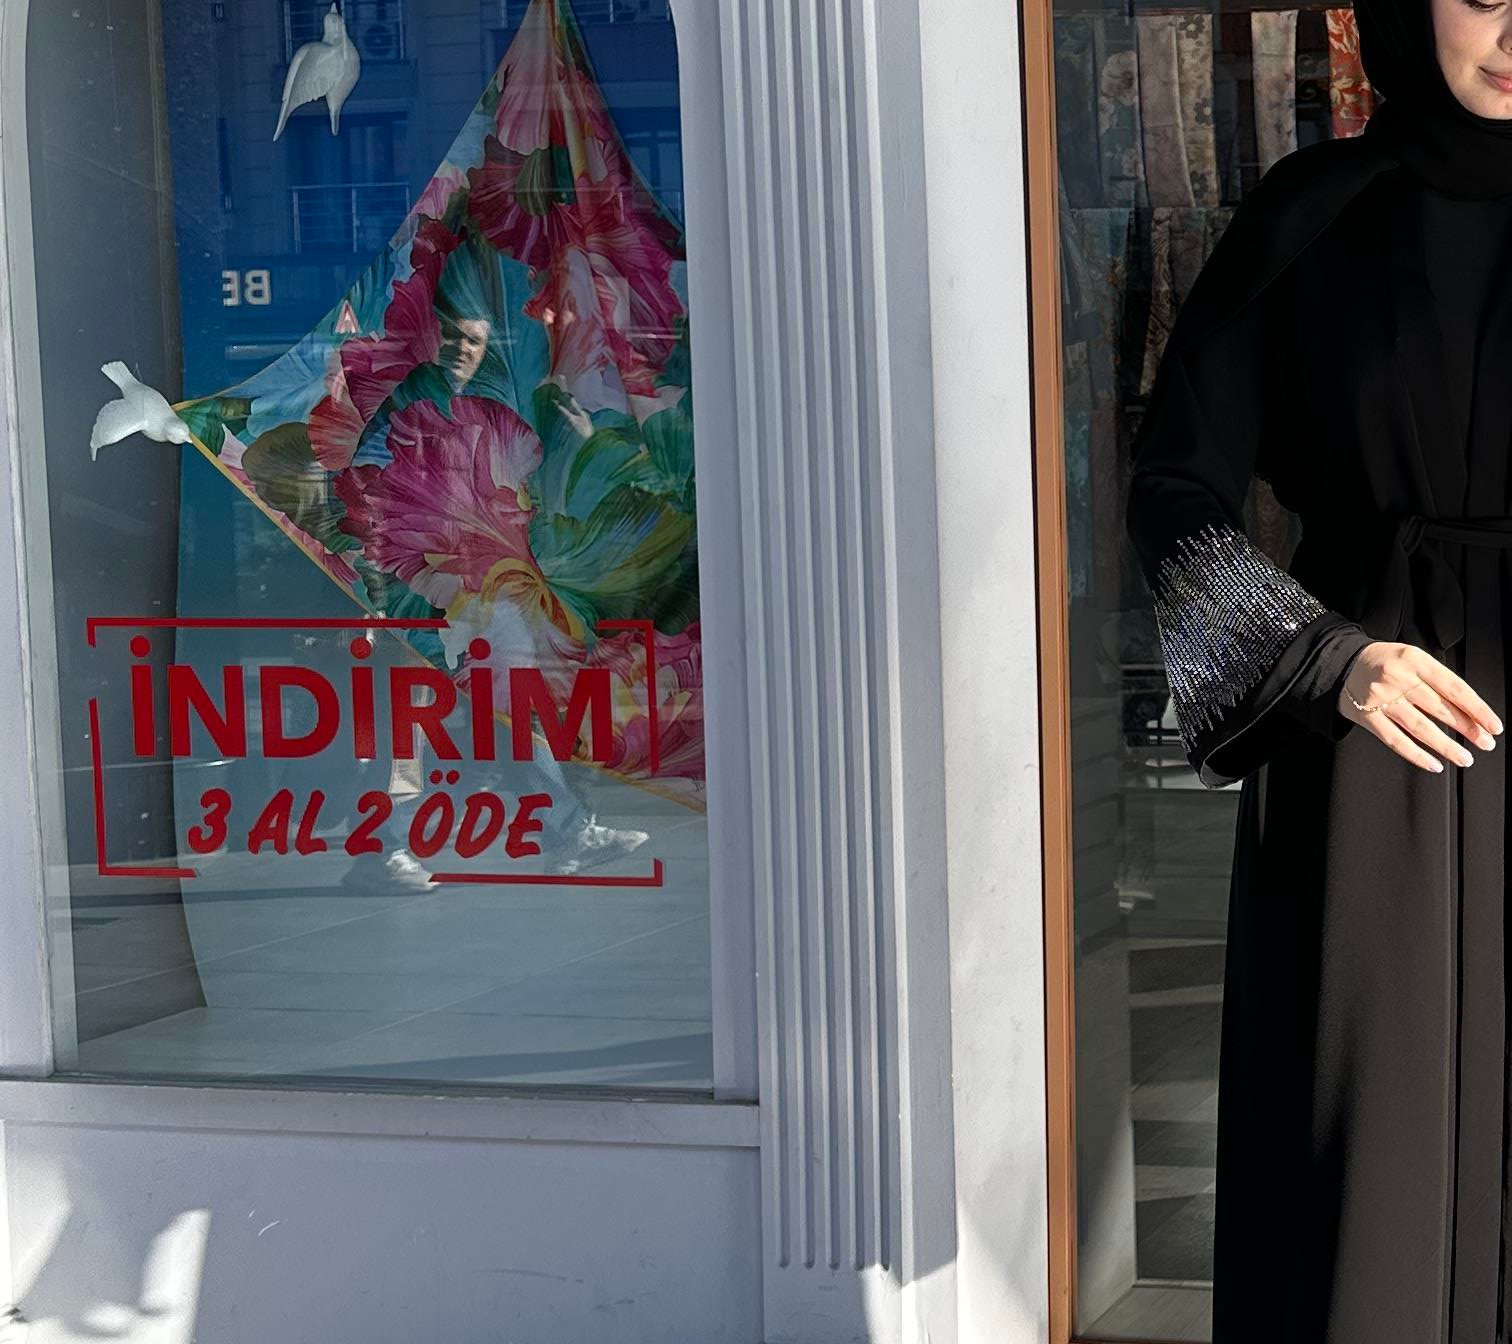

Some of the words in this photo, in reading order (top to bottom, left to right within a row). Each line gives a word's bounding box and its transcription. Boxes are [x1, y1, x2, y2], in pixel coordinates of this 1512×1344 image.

[128, 636, 615, 763] İNDİRİM
[187, 789, 233, 855] 3
[247, 788, 330, 858] AL
[345, 790, 393, 858] 2
[409, 771, 554, 861] ÖDE
